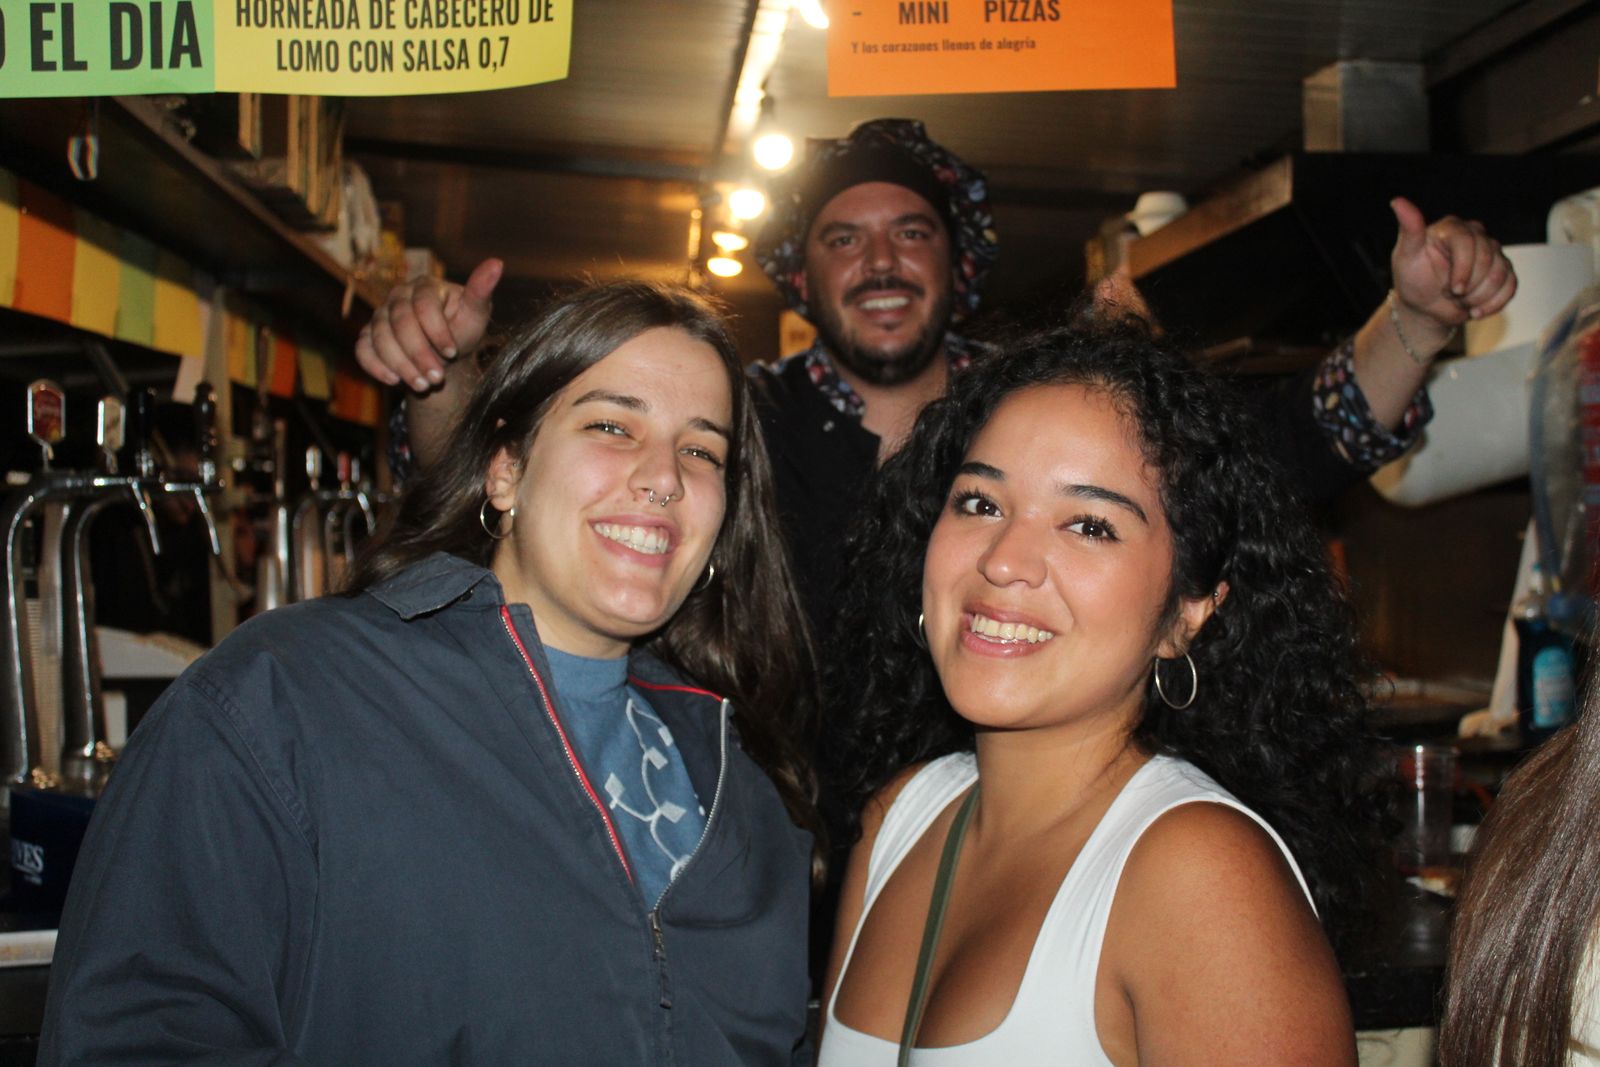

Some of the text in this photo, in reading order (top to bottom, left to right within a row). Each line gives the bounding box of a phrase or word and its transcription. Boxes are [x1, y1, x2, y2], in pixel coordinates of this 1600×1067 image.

[236, 0, 554, 29] HORNEADA DE CABECERO DE
[898, 0, 949, 24] MINI
[983, 0, 1061, 22] PIZZAS
[30, 2, 88, 71] EL
[109, 1, 203, 70] DIA
[851, 41, 858, 54] Y
[862, 41, 878, 54] los
[881, 42, 938, 53] corazones
[942, 38, 976, 51] llenos
[979, 38, 993, 50] de
[276, 36, 509, 72] LOMO CON SALSA 0,7
